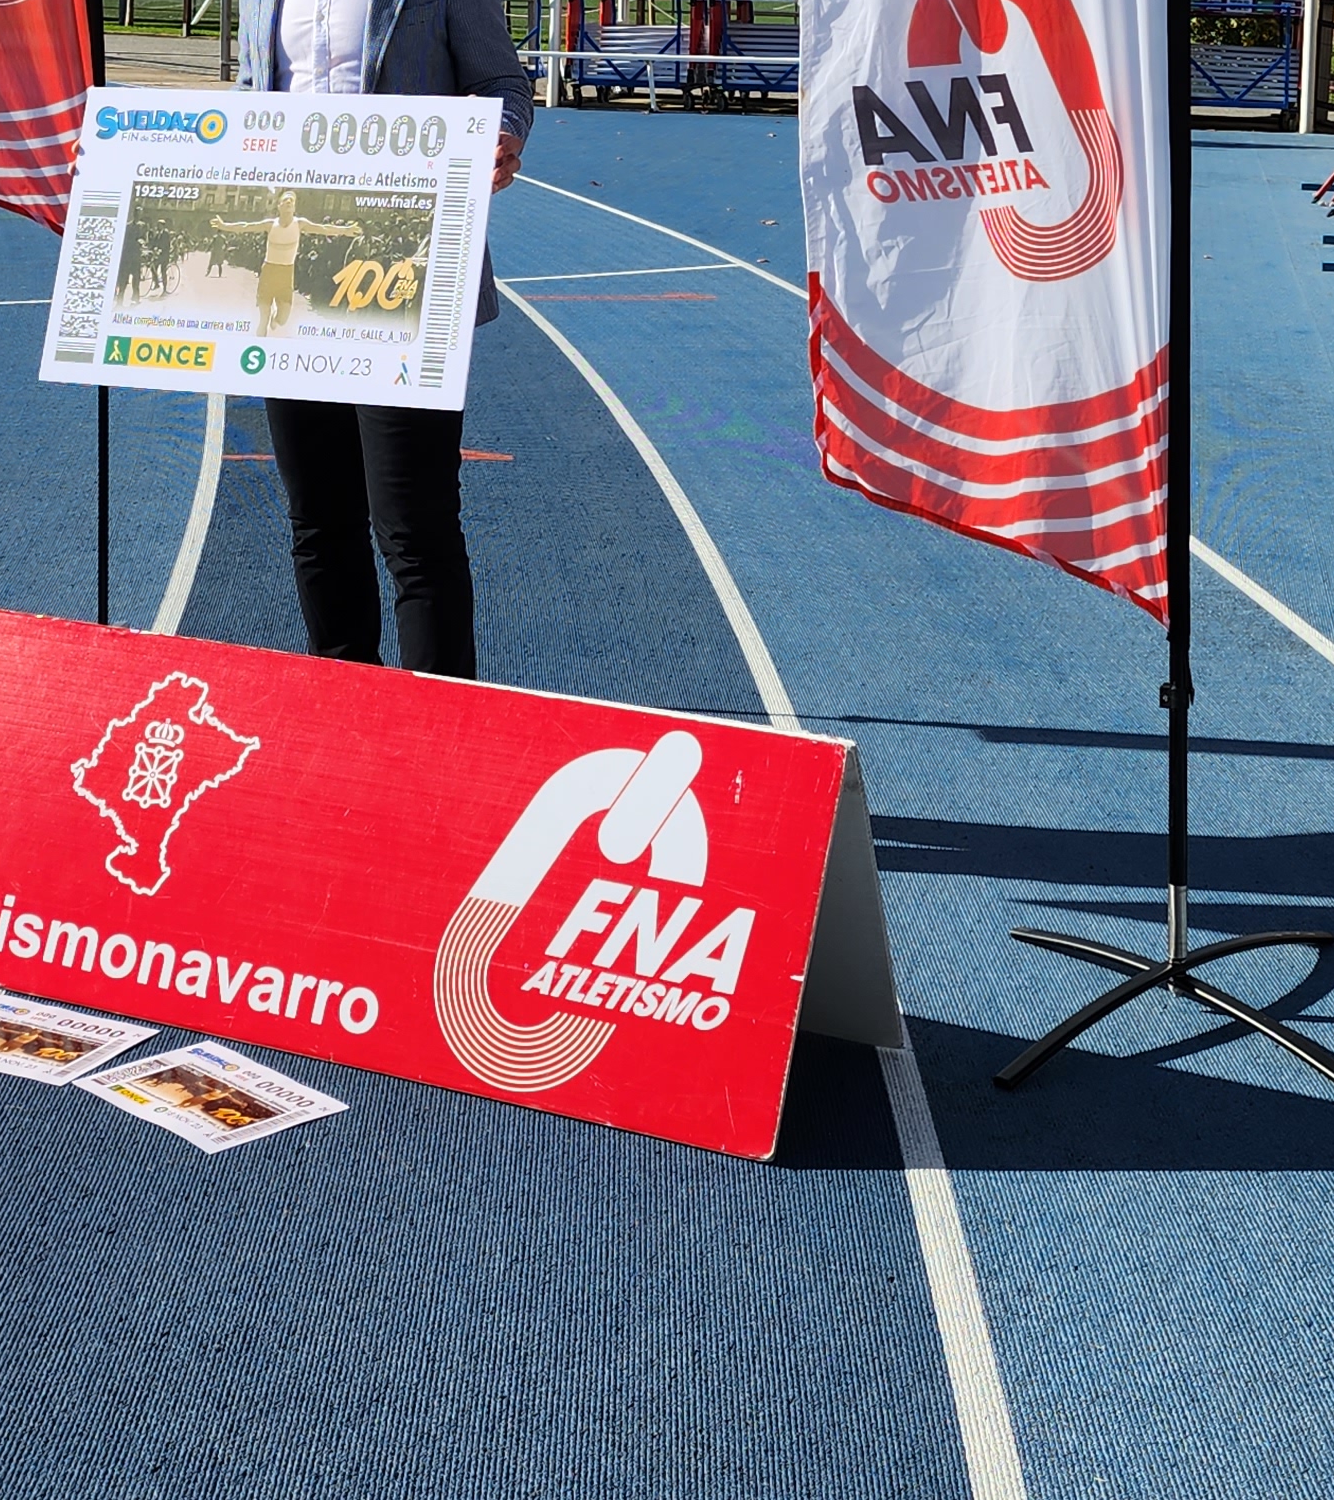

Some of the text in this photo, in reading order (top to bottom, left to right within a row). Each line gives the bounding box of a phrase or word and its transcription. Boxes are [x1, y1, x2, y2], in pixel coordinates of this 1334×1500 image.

[96, 106, 228, 144] SUELDAZO
[244, 110, 286, 131] 000
[466, 116, 487, 135] 2€
[150, 133, 194, 144] SEMANA
[242, 138, 278, 152] SERIE
[301, 112, 447, 157] 00000
[136, 163, 437, 188] Centenario de la Federación Navarra de Atletismo
[427, 161, 434, 170] R
[134, 185, 200, 199] 1923-2023
[355, 196, 433, 210] www.fnaf.es
[329, 258, 415, 312] 100
[177, 319, 185, 328] en
[200, 321, 224, 331] carrera
[225, 322, 234, 331] en
[235, 321, 251, 332] 1933
[135, 342, 209, 367] ONCE
[269, 352, 290, 371] 18
[295, 354, 345, 375] NOV.
[349, 357, 373, 376] 23
[544, 877, 756, 996] FNA
[520, 959, 731, 1032] ATLETISMO
[57, 1018, 126, 1038] 00000
[255, 1080, 316, 1108] 00000
